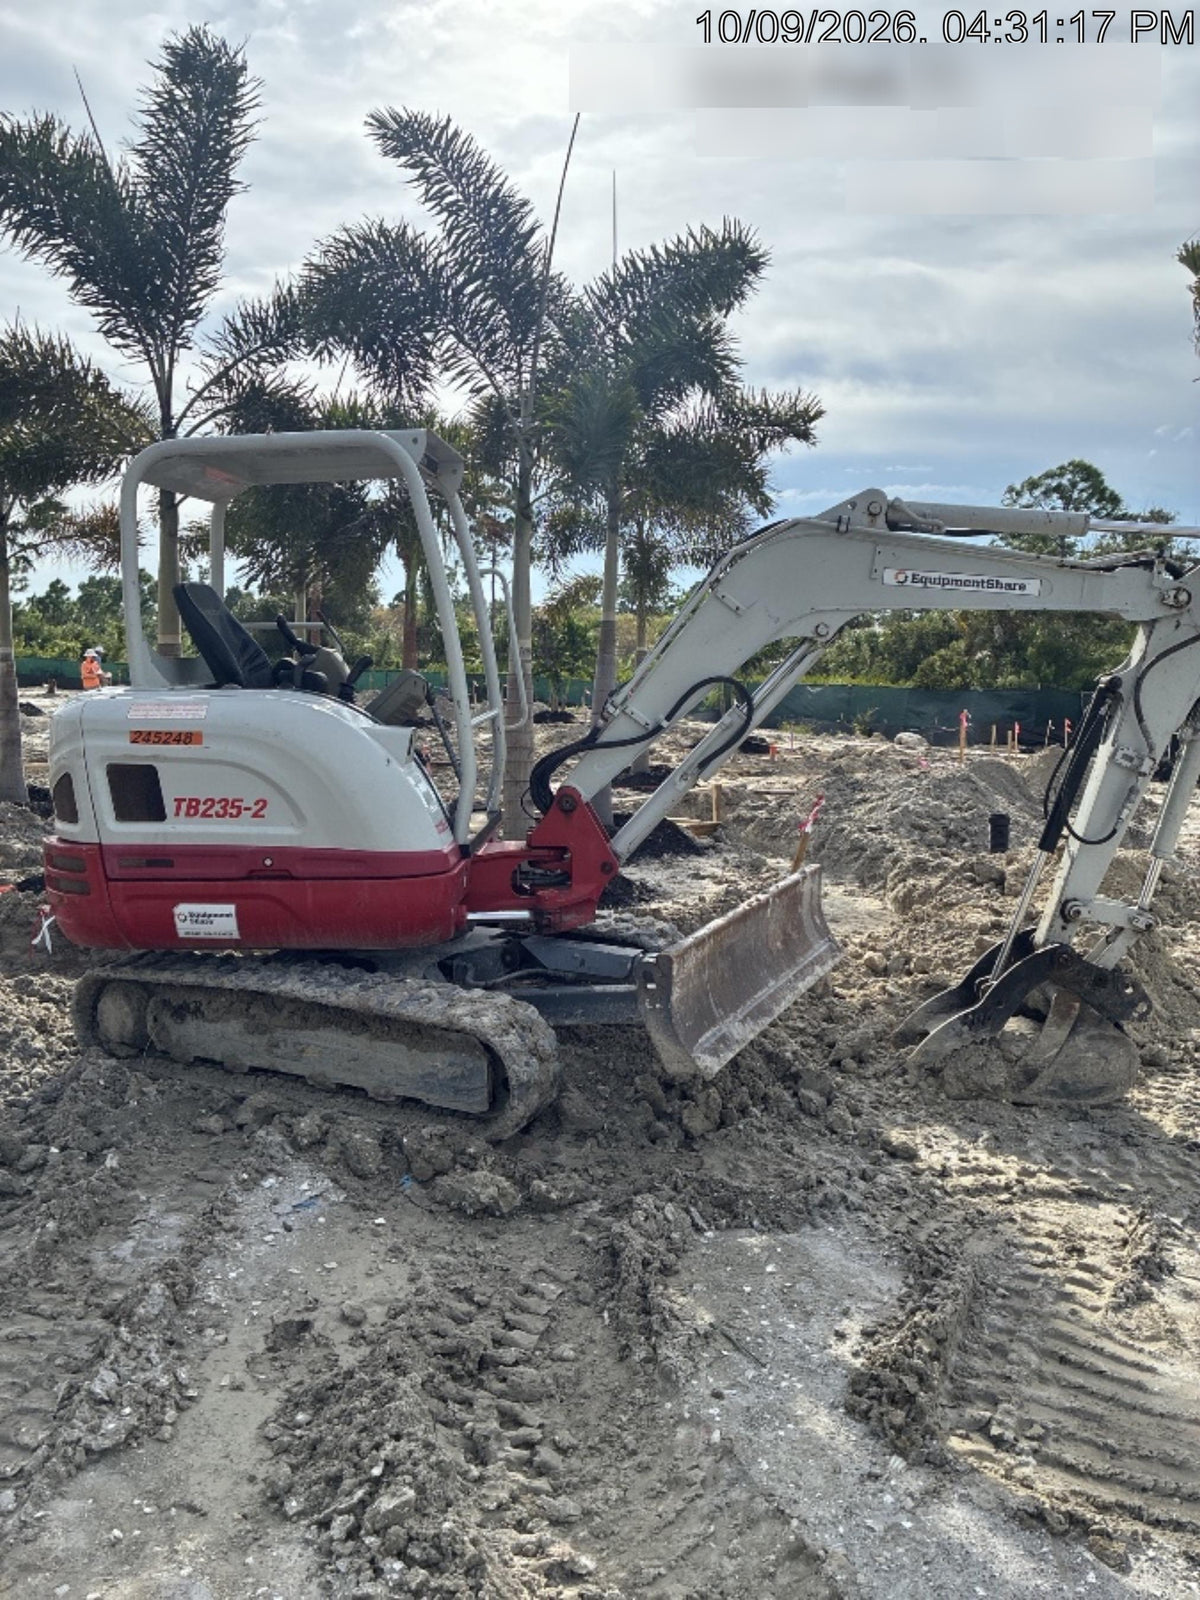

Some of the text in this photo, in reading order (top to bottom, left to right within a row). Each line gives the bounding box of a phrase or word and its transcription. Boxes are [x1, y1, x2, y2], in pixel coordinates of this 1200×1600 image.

[910, 573, 1027, 592] EquipmentShare
[129, 730, 193, 746] 245248
[173, 797, 268, 818] TB235-2
